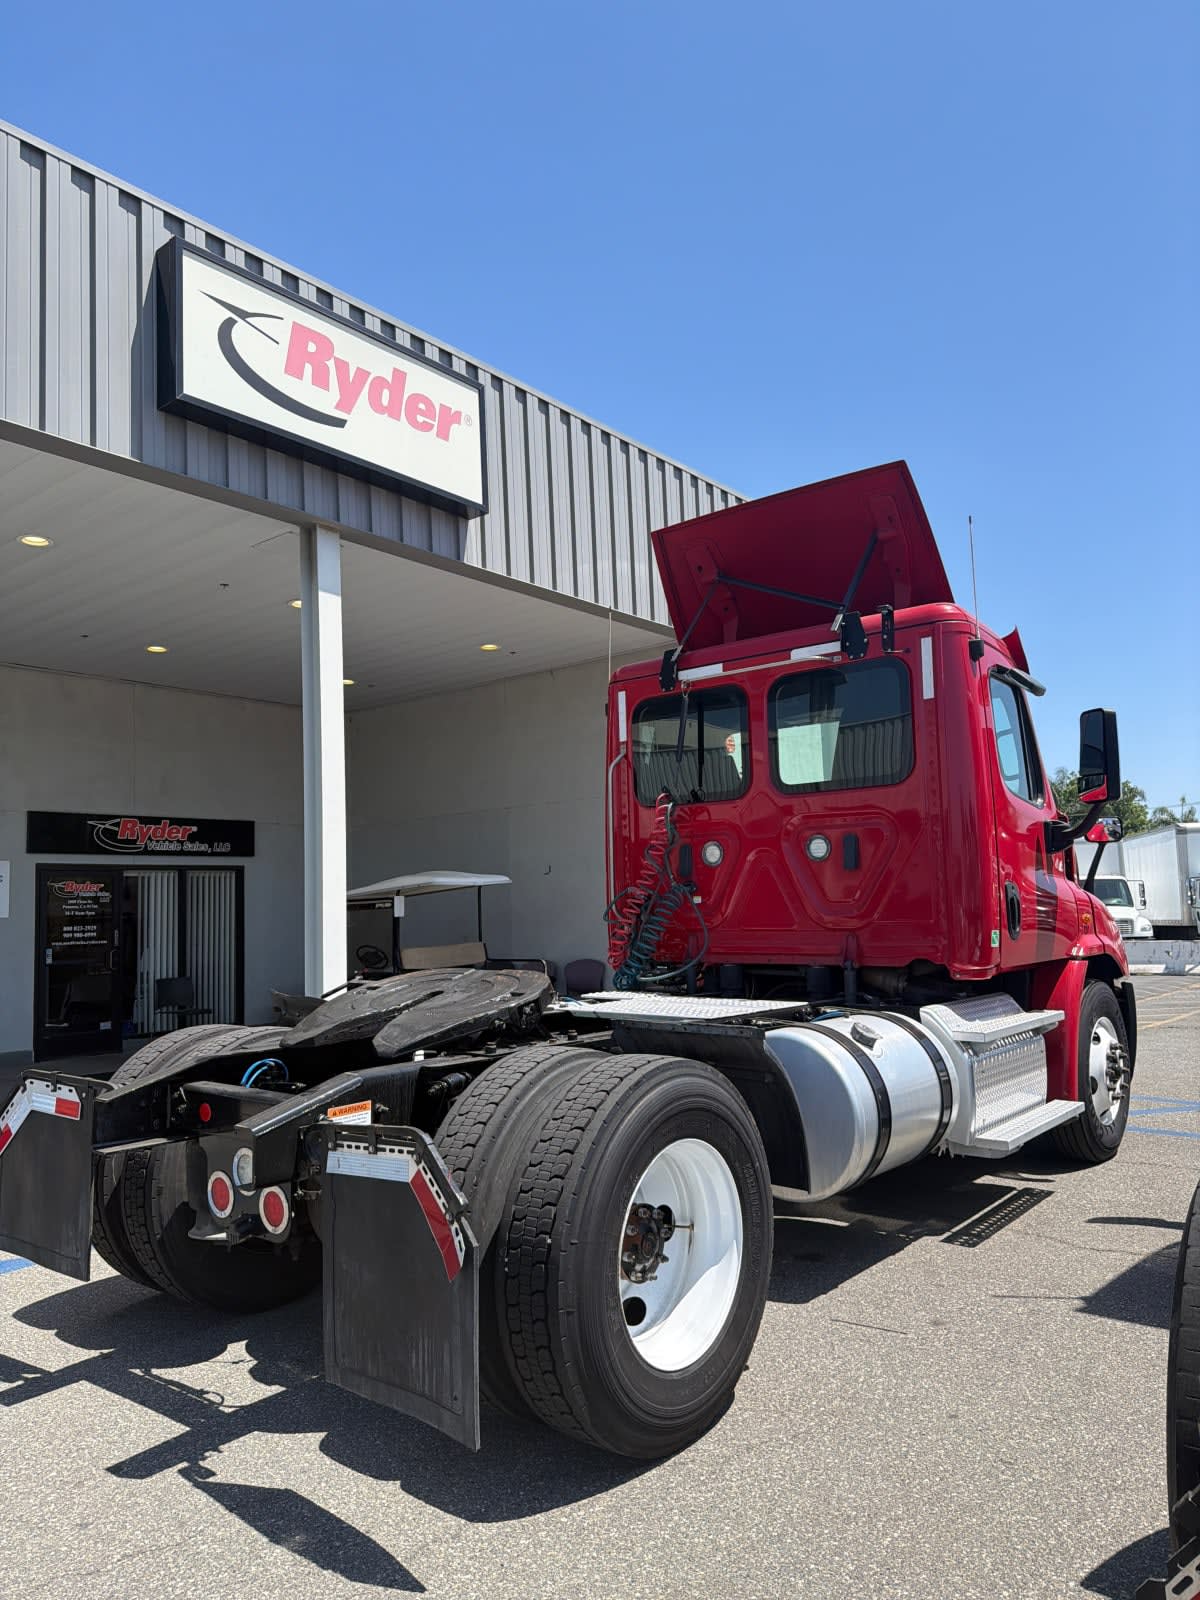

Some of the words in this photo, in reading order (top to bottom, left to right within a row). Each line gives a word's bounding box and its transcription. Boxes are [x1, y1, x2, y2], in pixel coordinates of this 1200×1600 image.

[284, 321, 462, 442] Ryder
[117, 818, 193, 844] Ryder
[147, 840, 182, 851] Vehicle
[213, 842, 231, 852] LLC
[64, 881, 102, 893] Ryder
[338, 1103, 367, 1115] WARNING
